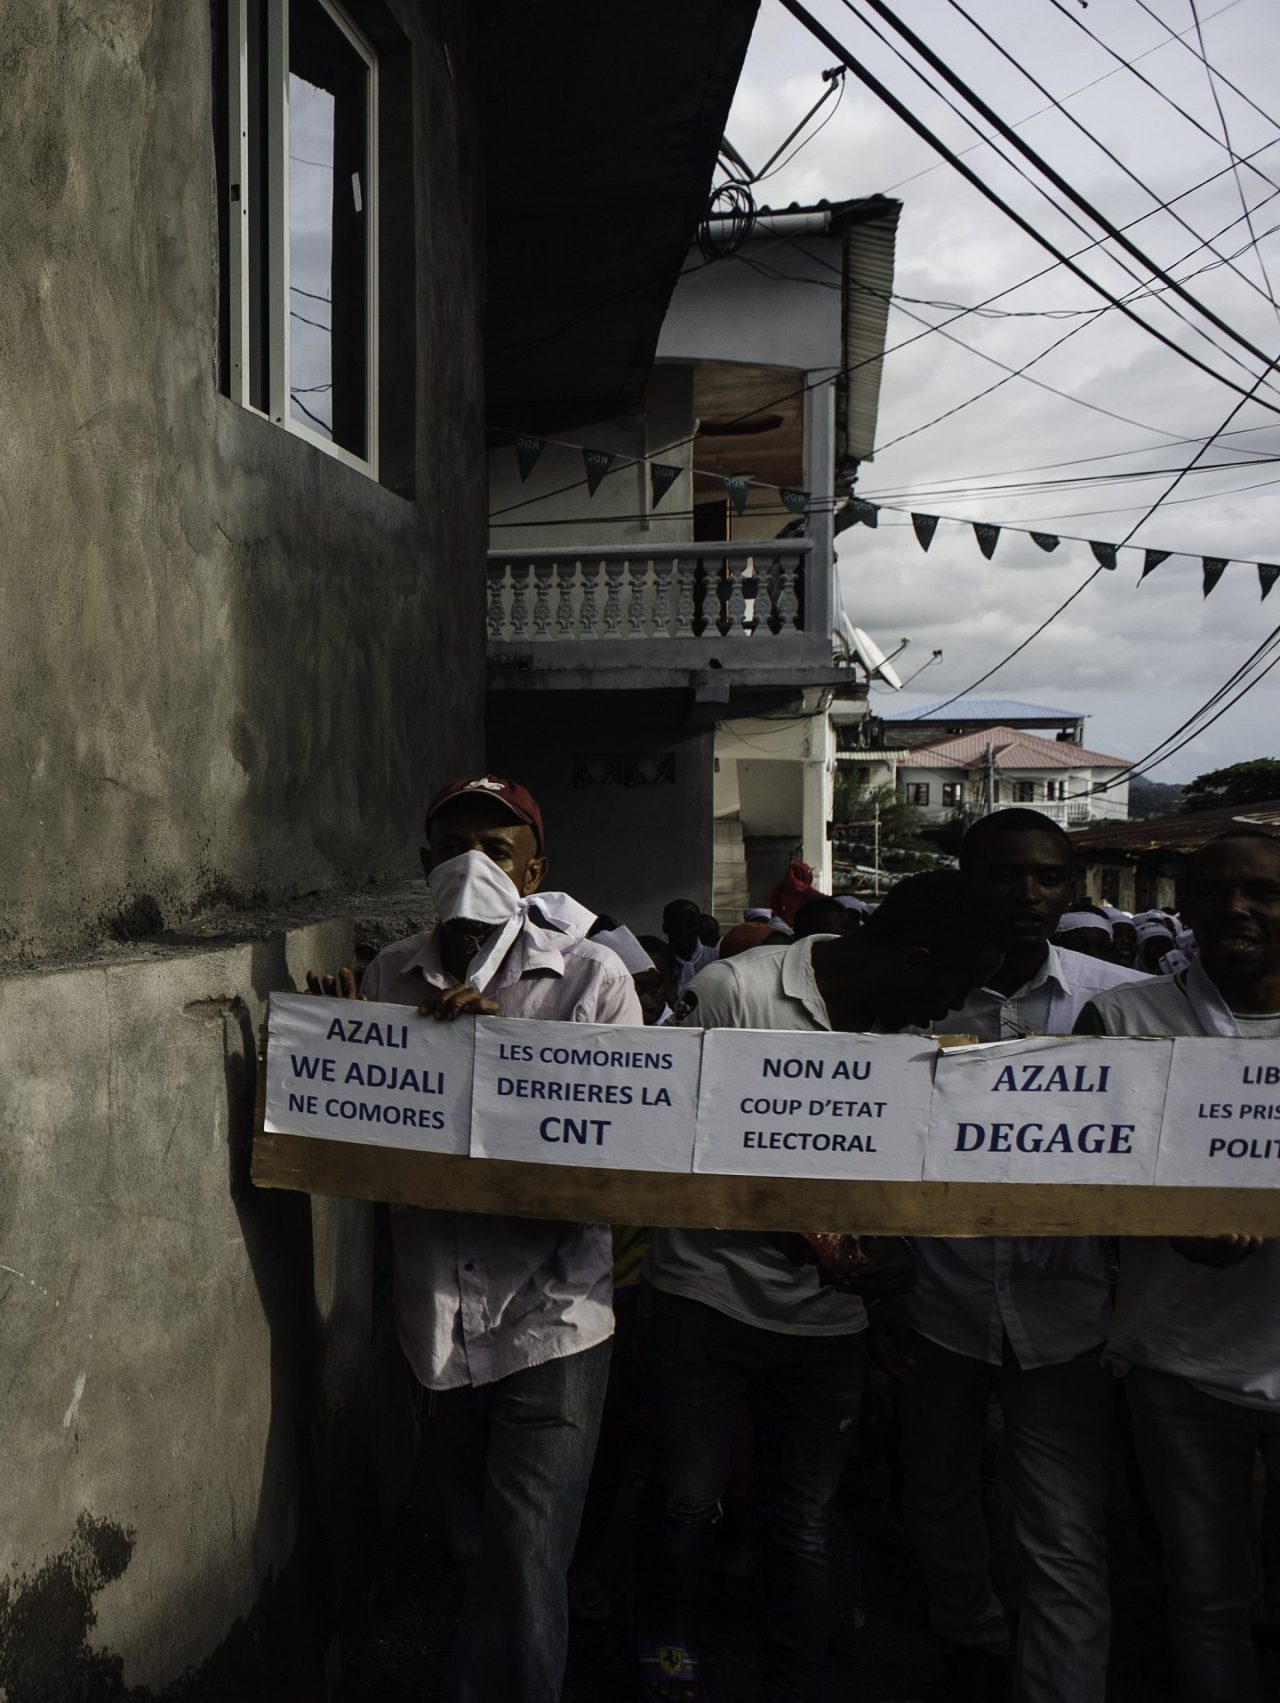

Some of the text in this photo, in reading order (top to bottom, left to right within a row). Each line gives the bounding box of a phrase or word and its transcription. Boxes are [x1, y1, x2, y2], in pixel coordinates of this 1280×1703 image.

[327, 1018, 407, 1048] AZALI
[500, 1044, 672, 1069] LES COMORIENS
[763, 1059, 871, 1080] NON AU
[291, 1055, 444, 1094] WE ADJALI
[992, 1066, 1110, 1092] AZALI
[1243, 1066, 1280, 1084] LIB
[498, 1078, 672, 1106] DERRIERES LA
[289, 1094, 444, 1129] NE COMORES
[741, 1098, 802, 1114] COUP
[1199, 1104, 1232, 1118] LES
[540, 1117, 611, 1145] CNT
[744, 1132, 876, 1152] ELECTORAL
[954, 1123, 1135, 1153] DEGAGE
